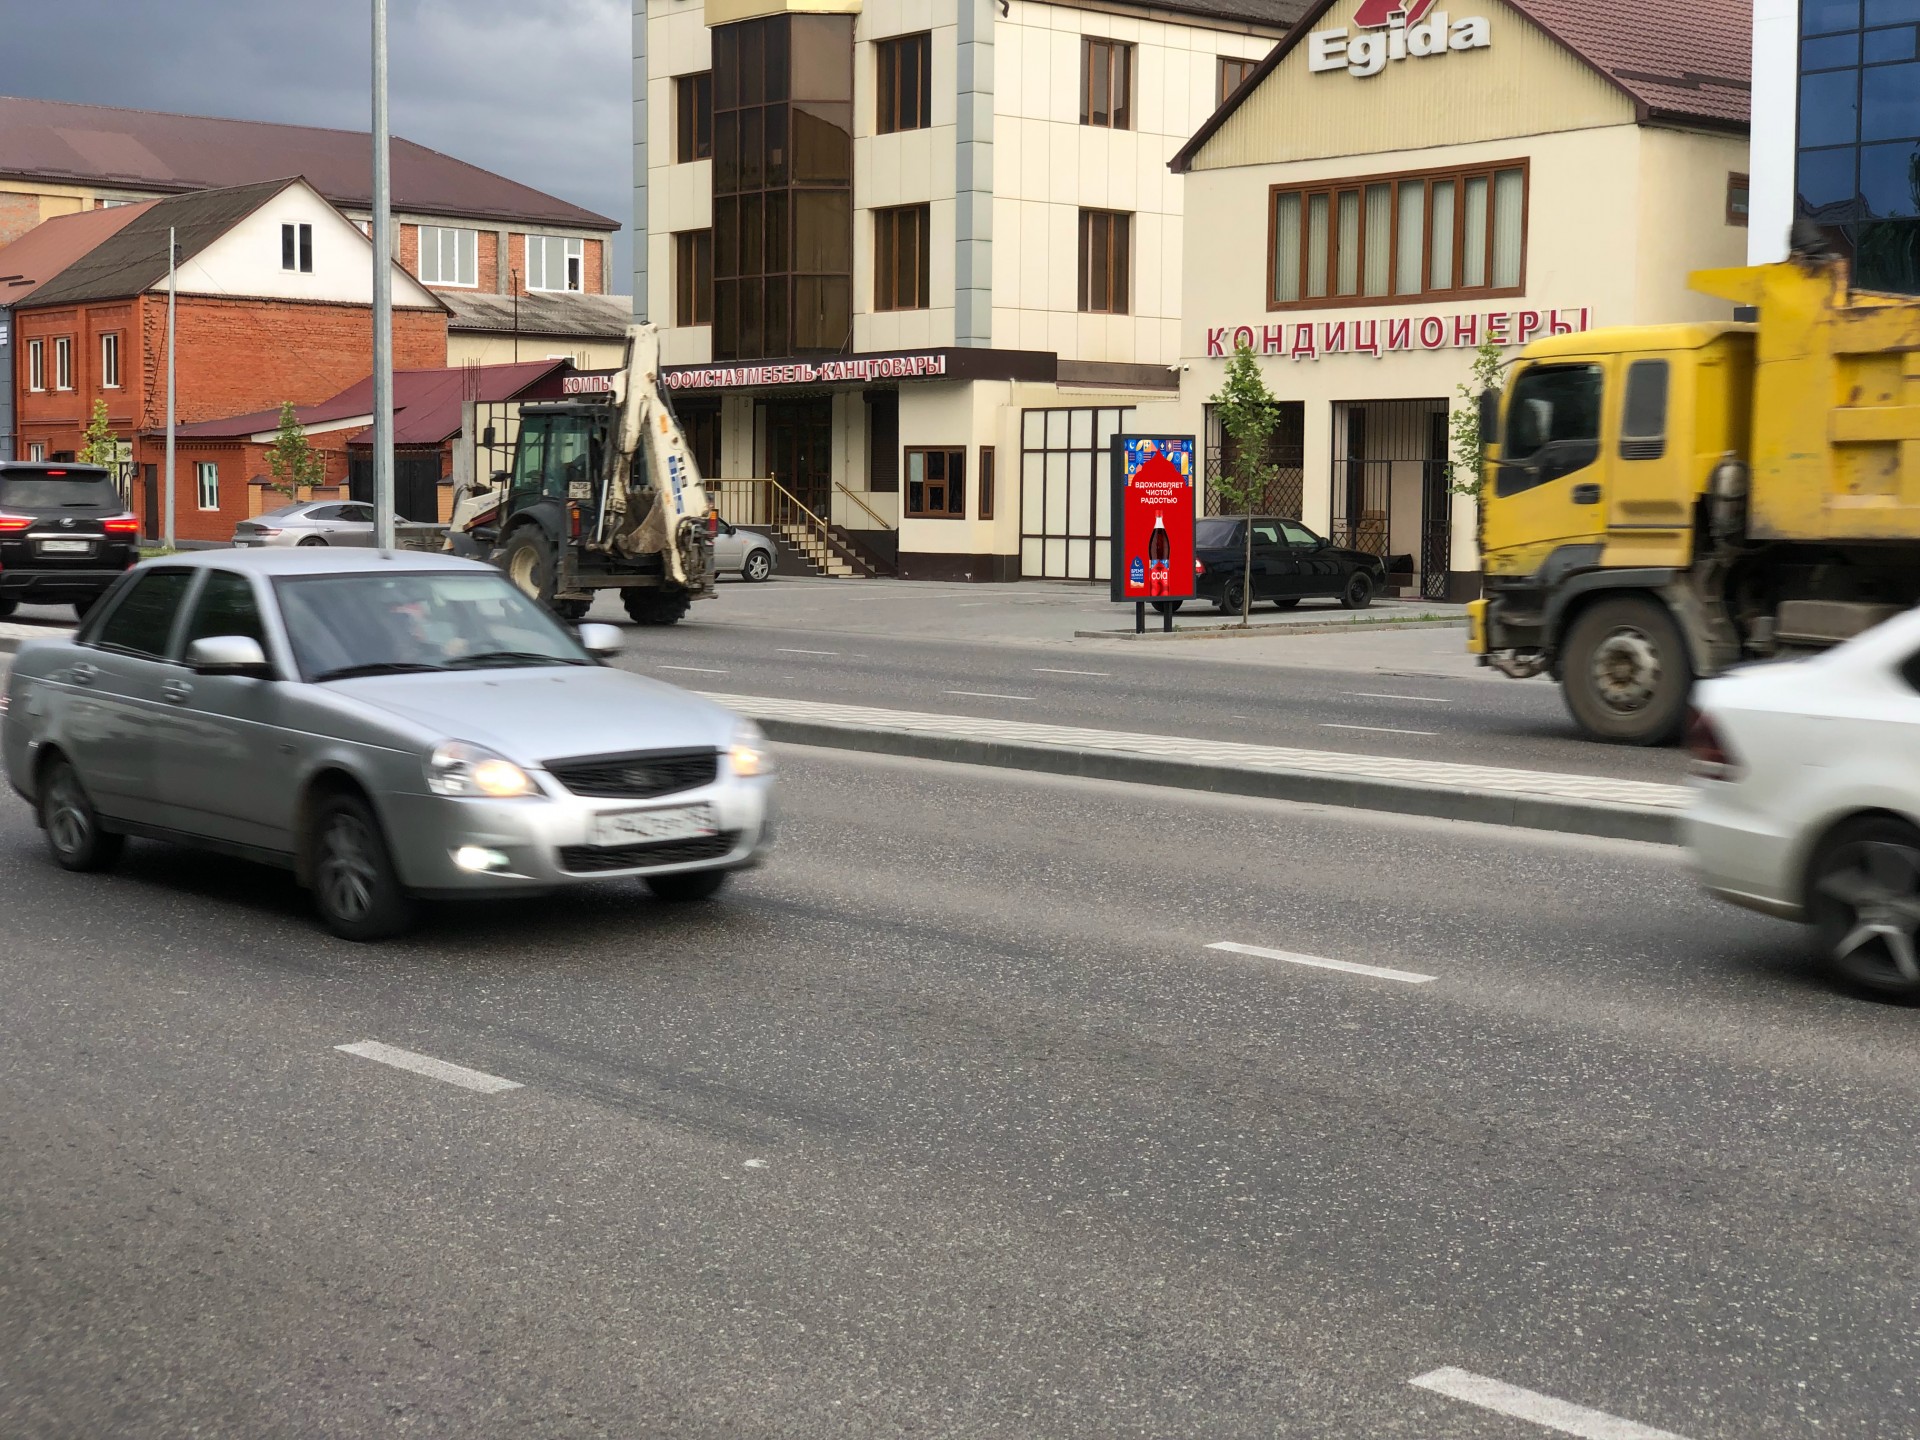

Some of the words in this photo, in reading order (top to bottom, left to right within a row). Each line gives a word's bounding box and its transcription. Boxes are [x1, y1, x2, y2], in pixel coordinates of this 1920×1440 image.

[1308, 11, 1491, 77] Egida
[1206, 307, 1592, 360] КОНДИЦИОНЕРЫ
[669, 368, 748, 390] ОФИСНАЯ
[748, 364, 816, 385] МЕБЕЛЬ
[821, 355, 946, 382] КАНЦТОВАРЫ
[1135, 481, 1183, 489] ВДОХНОВЛЯЕТ
[1145, 488, 1173, 496] ЧИСТОЙ
[1151, 571, 1168, 580] cola
